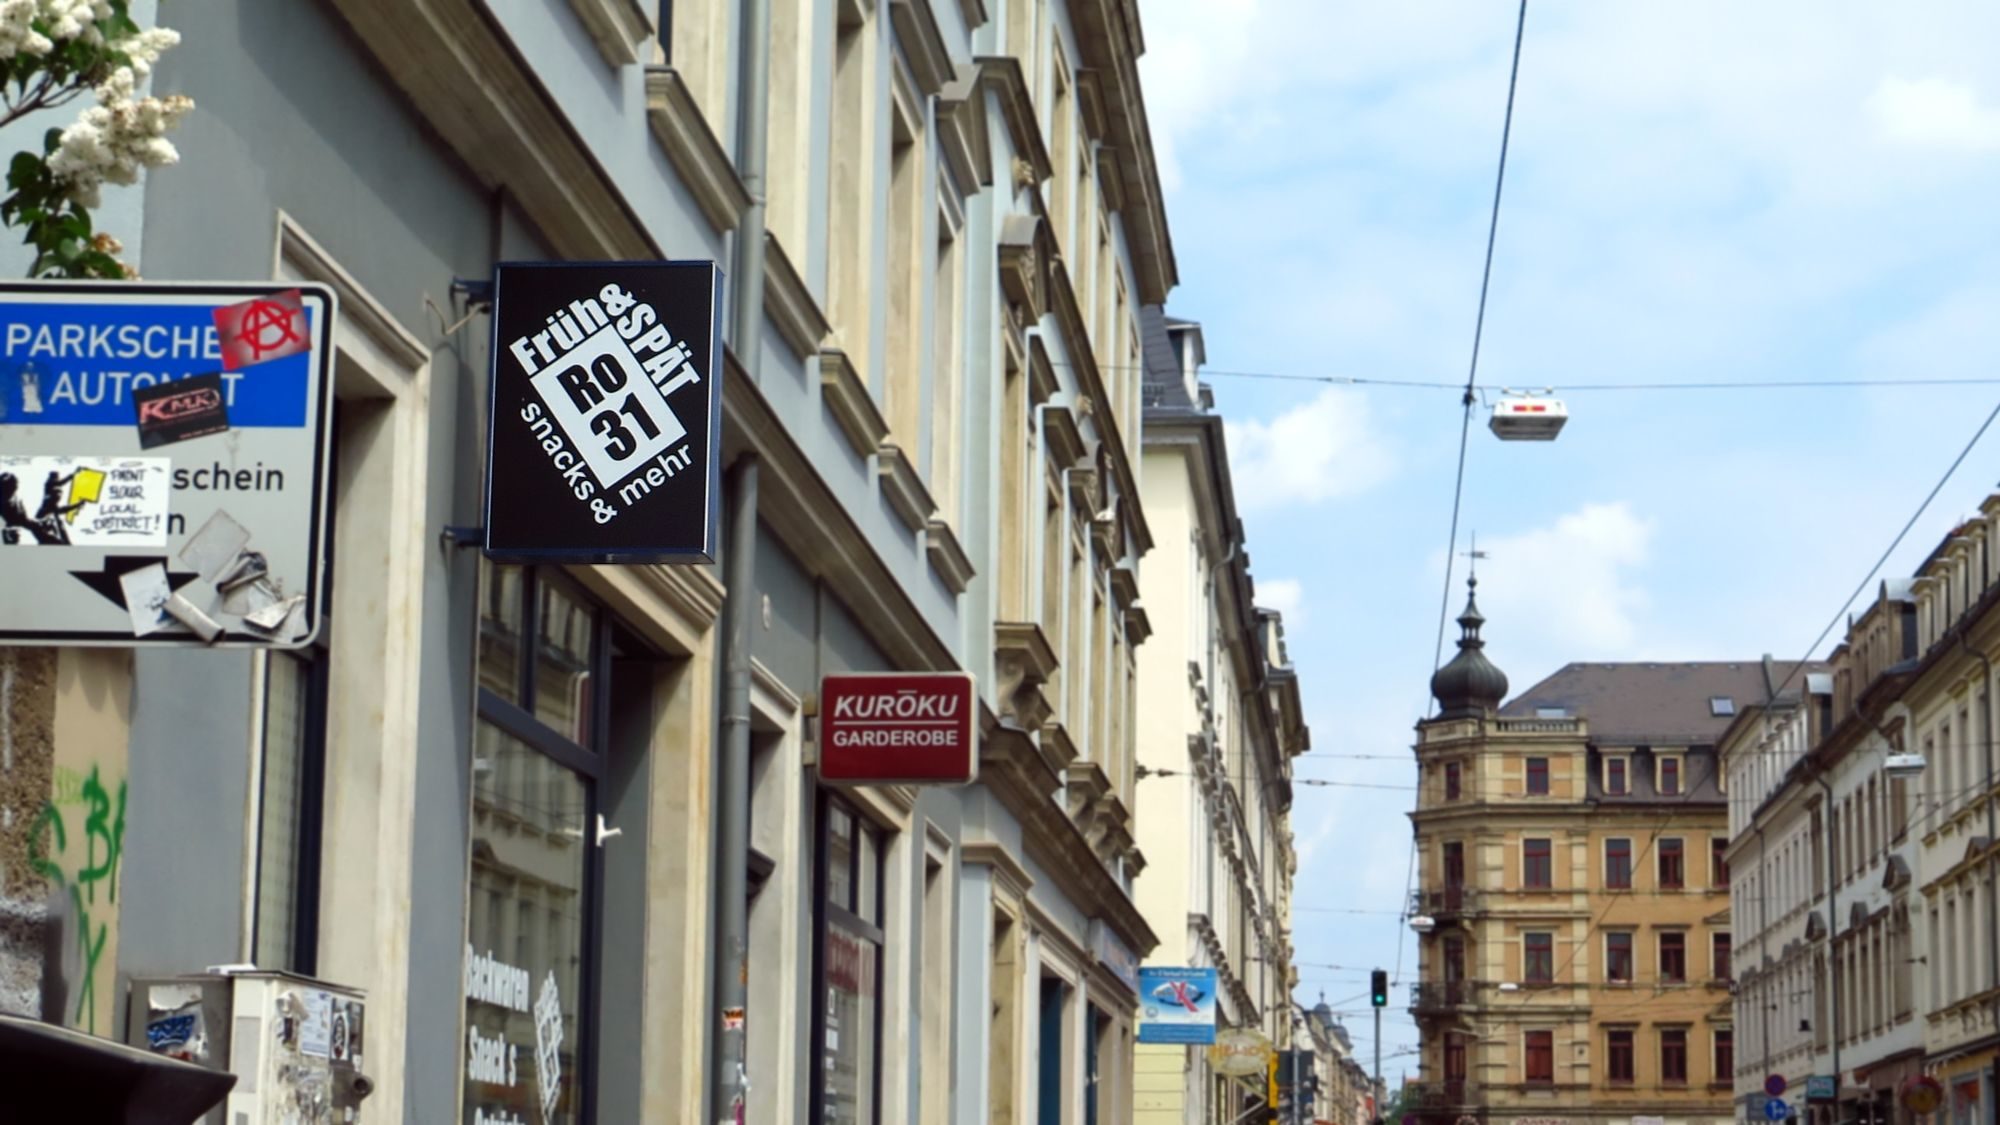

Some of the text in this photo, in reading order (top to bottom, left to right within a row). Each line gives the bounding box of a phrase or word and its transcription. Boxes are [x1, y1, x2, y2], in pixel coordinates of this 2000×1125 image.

[509, 283, 701, 397] Früh & SPÄT
[590, 393, 662, 462] 31
[520, 401, 693, 525] snacks & mehr
[832, 729, 959, 747] GARDEROBE
[833, 689, 959, 718] KURŌKU
